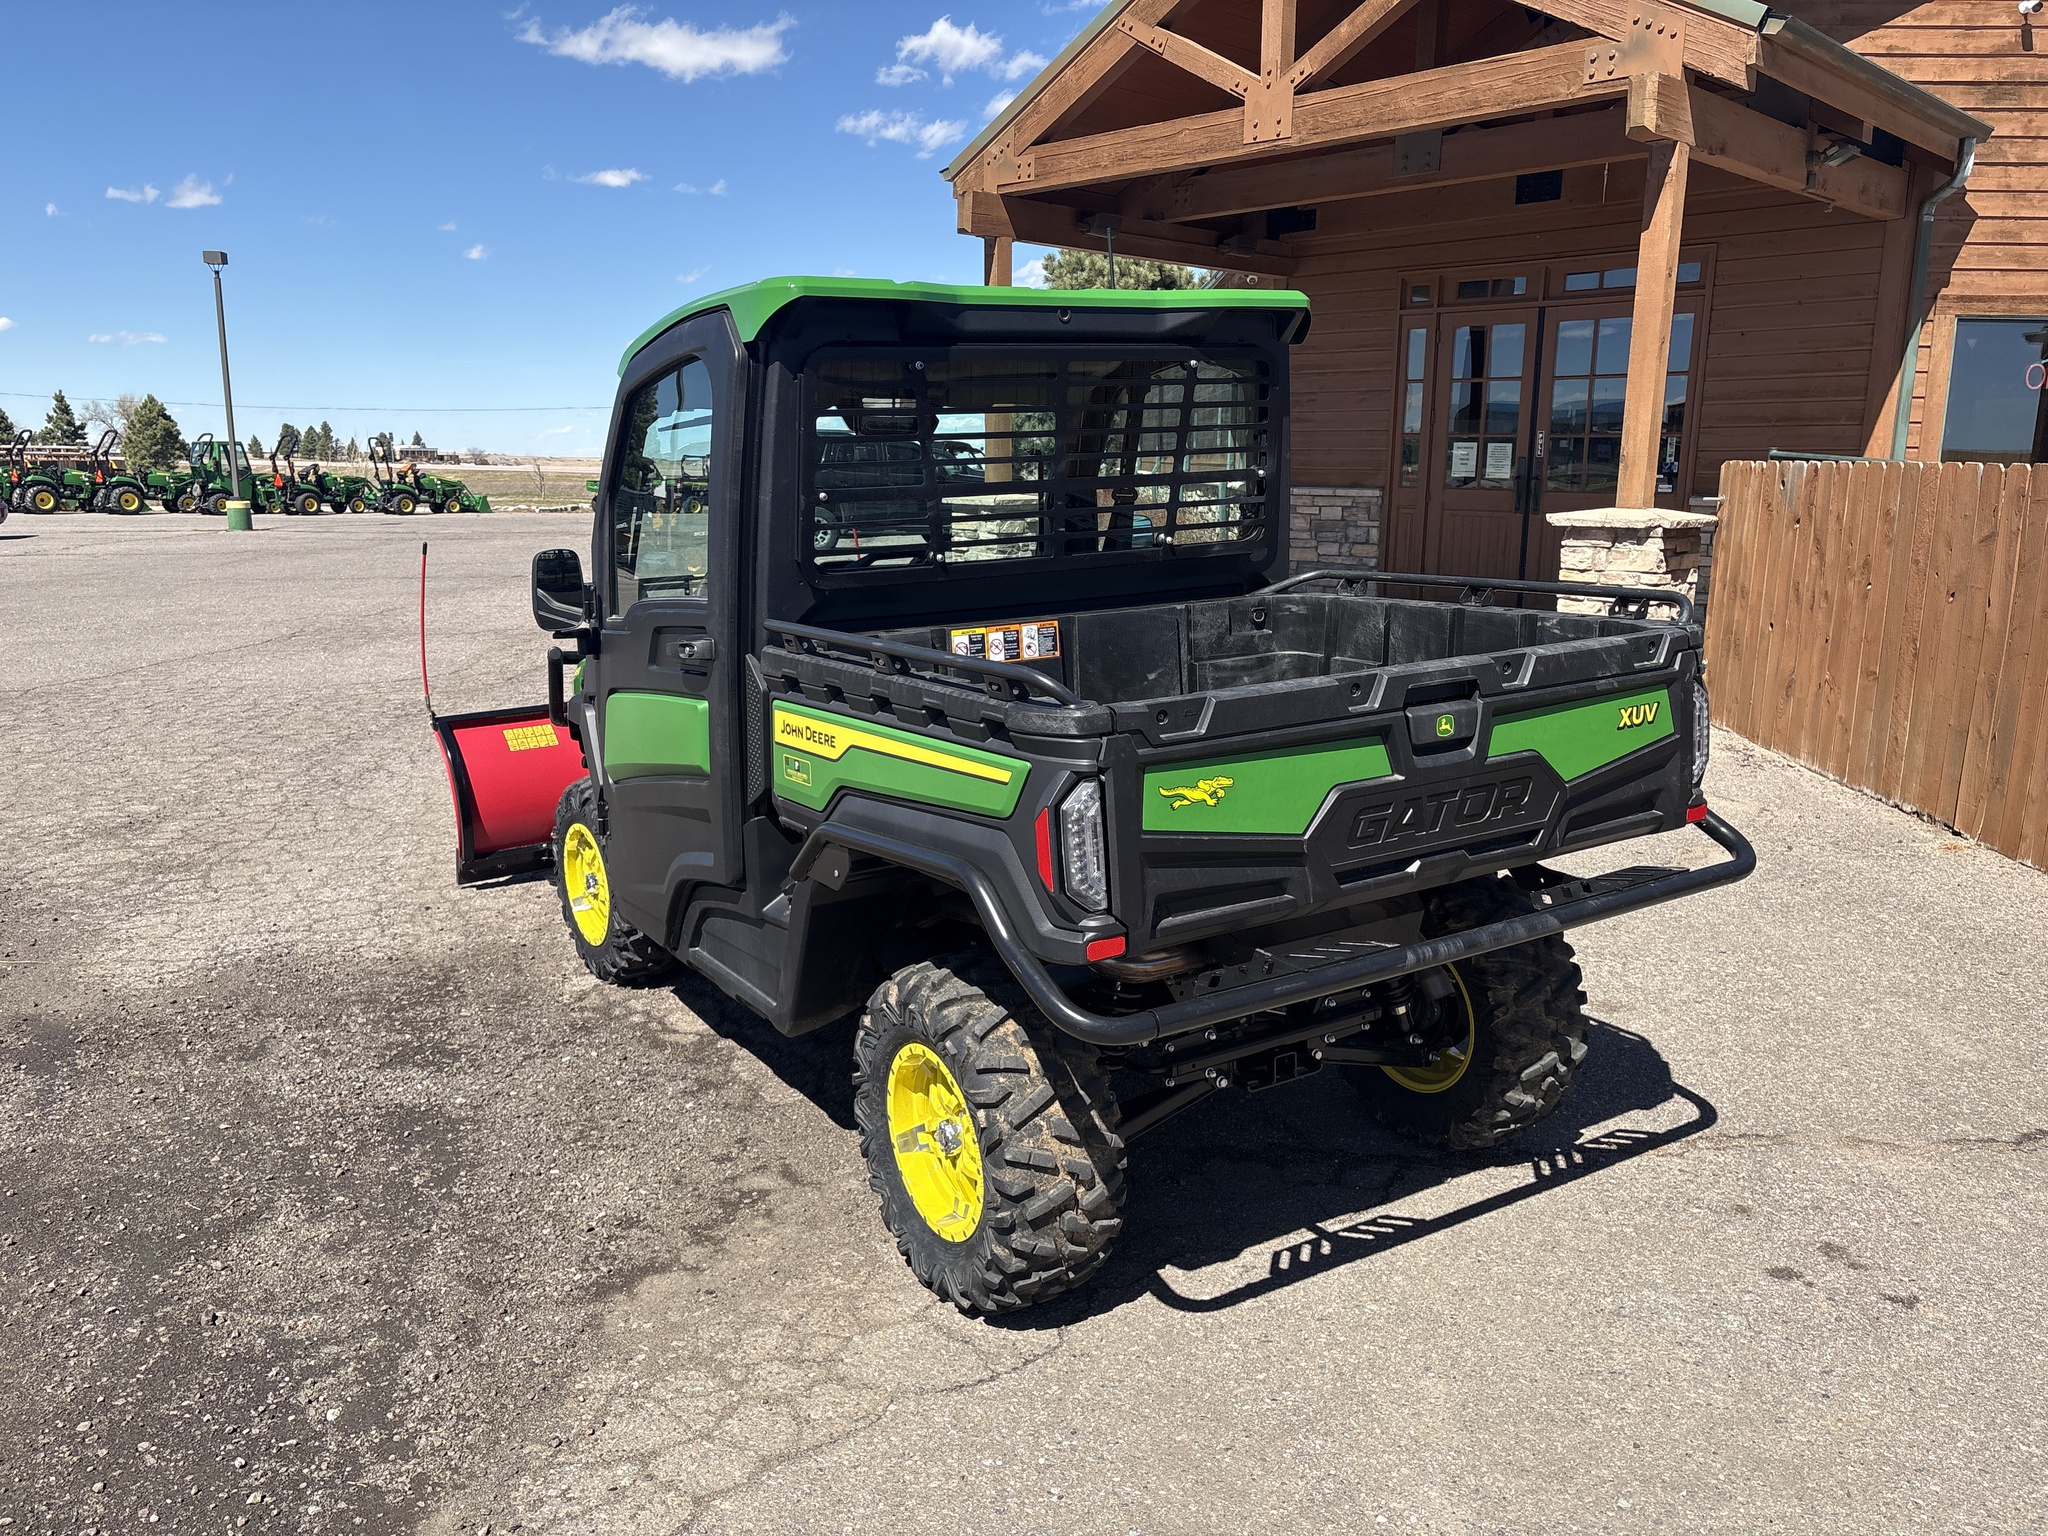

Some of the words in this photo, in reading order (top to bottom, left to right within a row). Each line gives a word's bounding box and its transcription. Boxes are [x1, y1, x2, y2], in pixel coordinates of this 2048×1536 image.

[1617, 701, 1659, 730] XUV
[781, 719, 804, 739] JOHN
[805, 726, 836, 748] DEERE
[1347, 775, 1533, 850] GATOR
